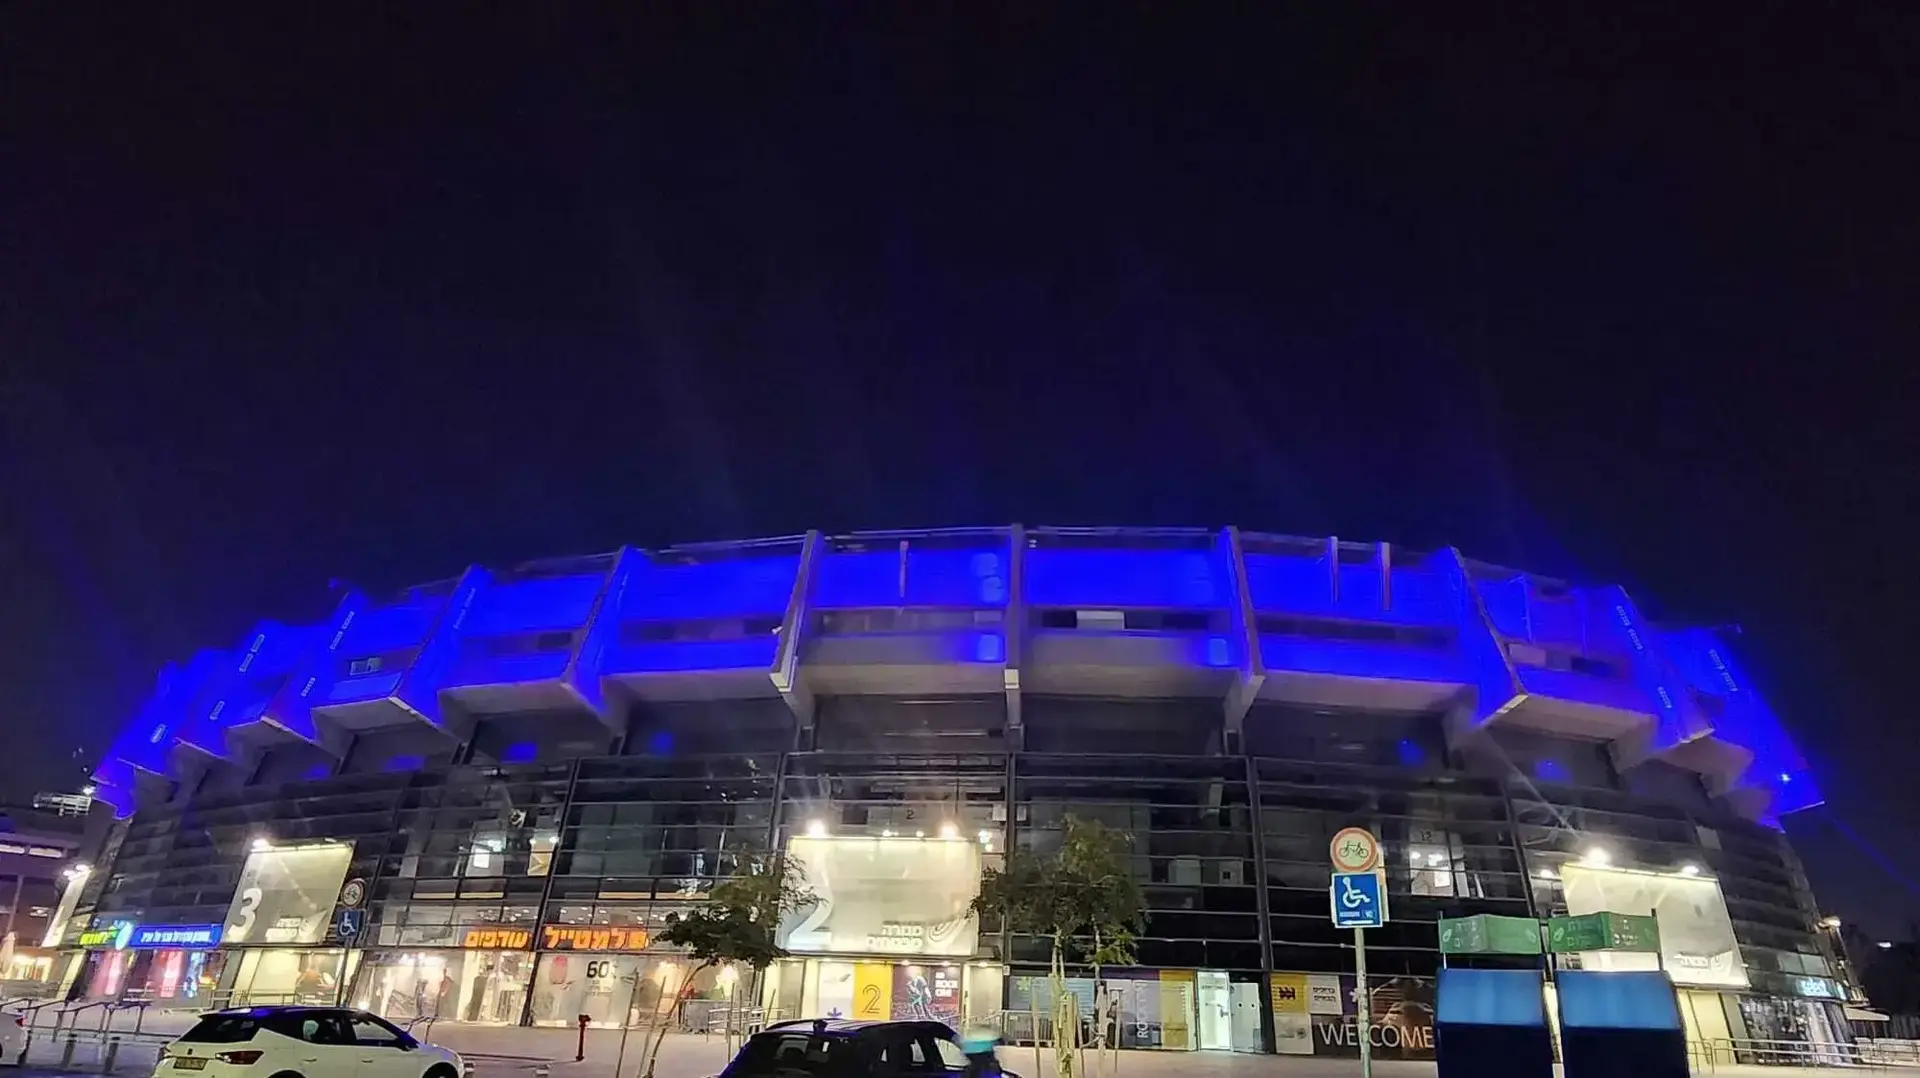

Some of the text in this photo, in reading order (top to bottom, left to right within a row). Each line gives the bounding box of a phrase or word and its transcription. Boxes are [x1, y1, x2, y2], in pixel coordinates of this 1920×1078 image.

[227, 887, 263, 942] 3
[784, 863, 834, 949] 2
[464, 930, 528, 948] עודפים
[862, 983, 881, 1014] 2
[1318, 1022, 1435, 1048] WECOME
